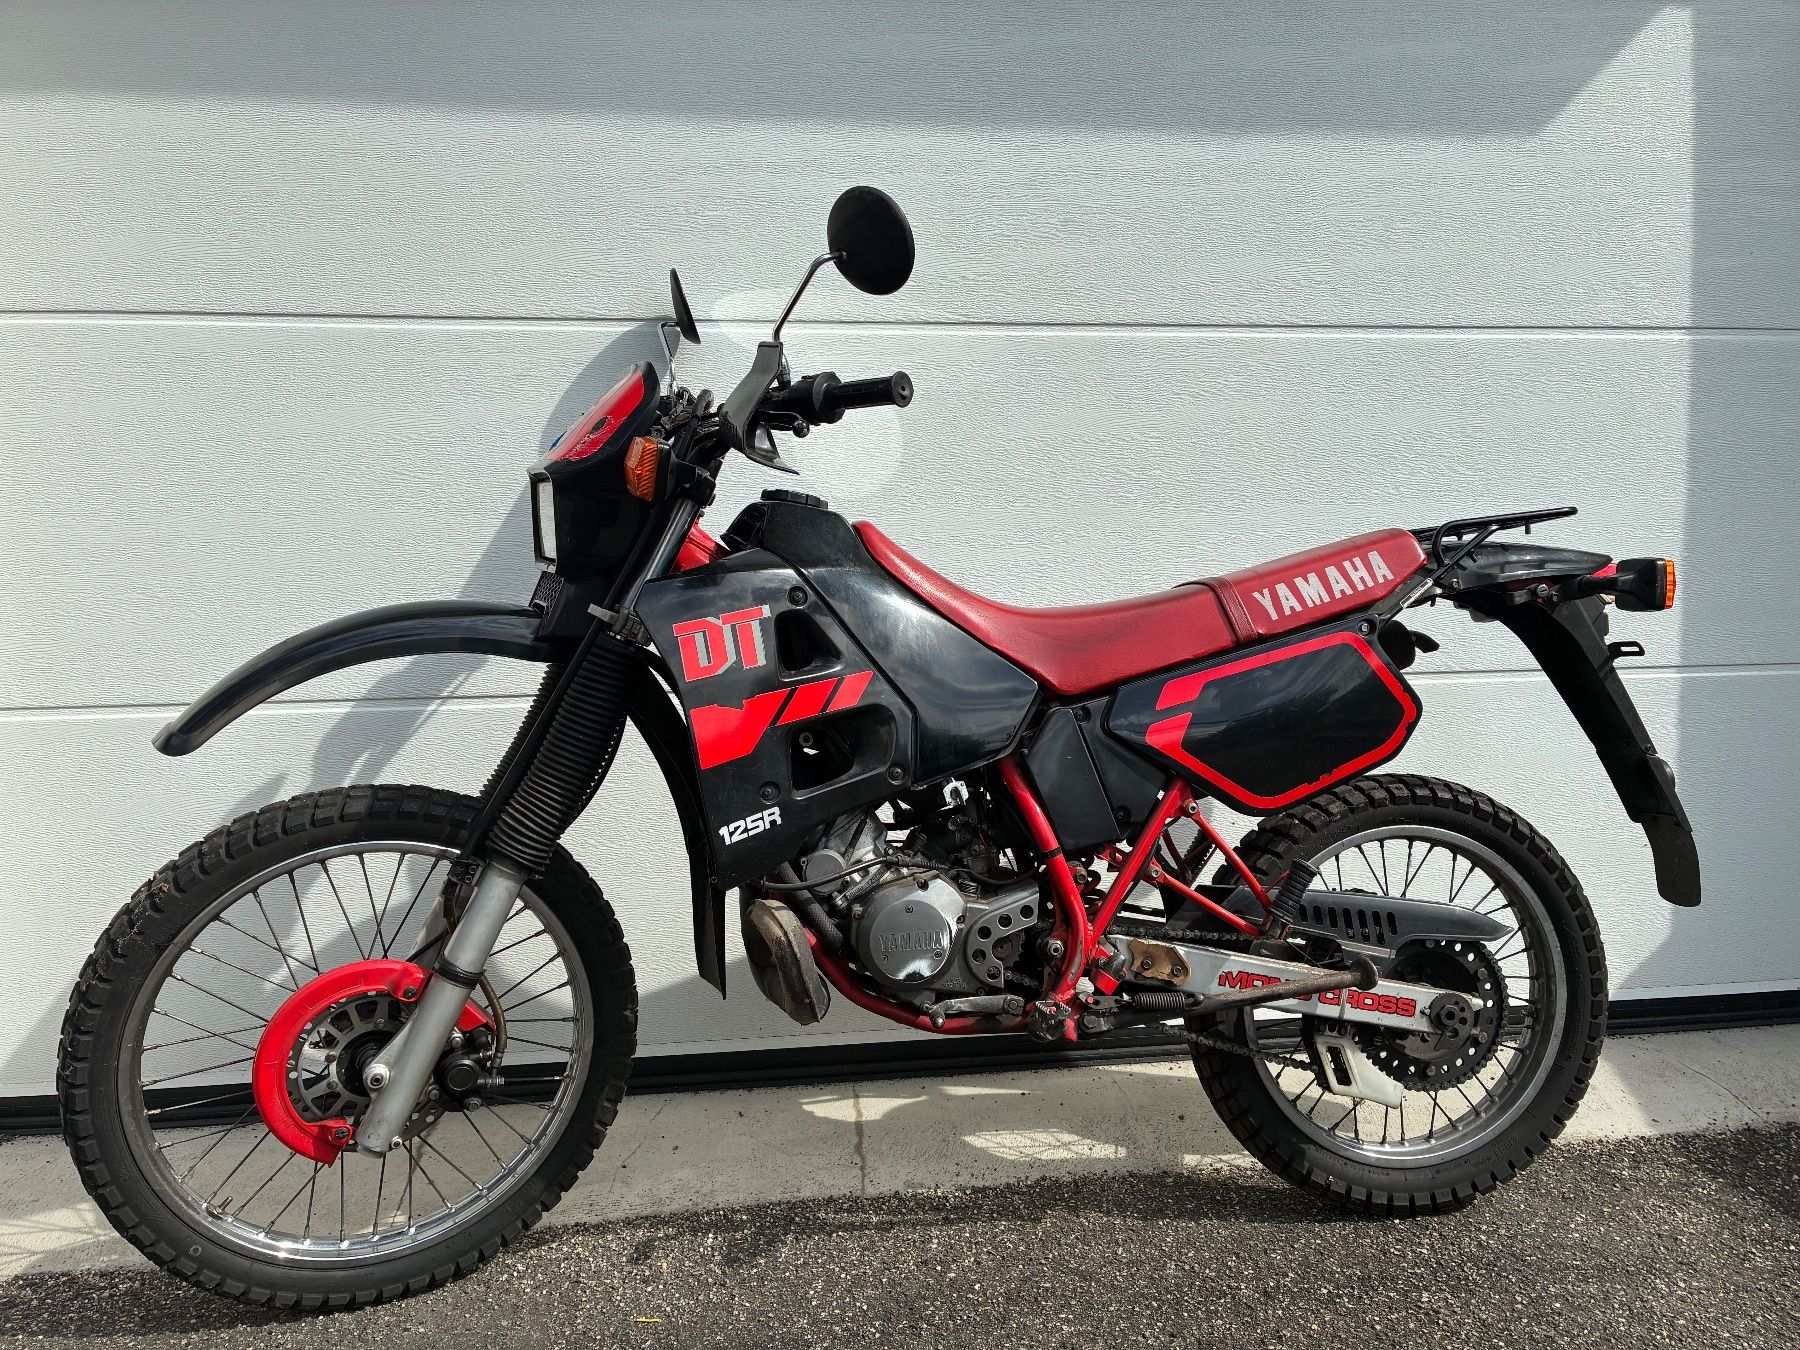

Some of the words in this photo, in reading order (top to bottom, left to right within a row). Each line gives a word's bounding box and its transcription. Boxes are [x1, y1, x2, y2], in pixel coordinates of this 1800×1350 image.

[1252, 550, 1395, 621] YAMAHA
[672, 604, 772, 682] DT
[718, 806, 782, 846] 125R
[879, 929, 944, 952] YAMAHA
[1318, 985, 1416, 1017] CROSS
